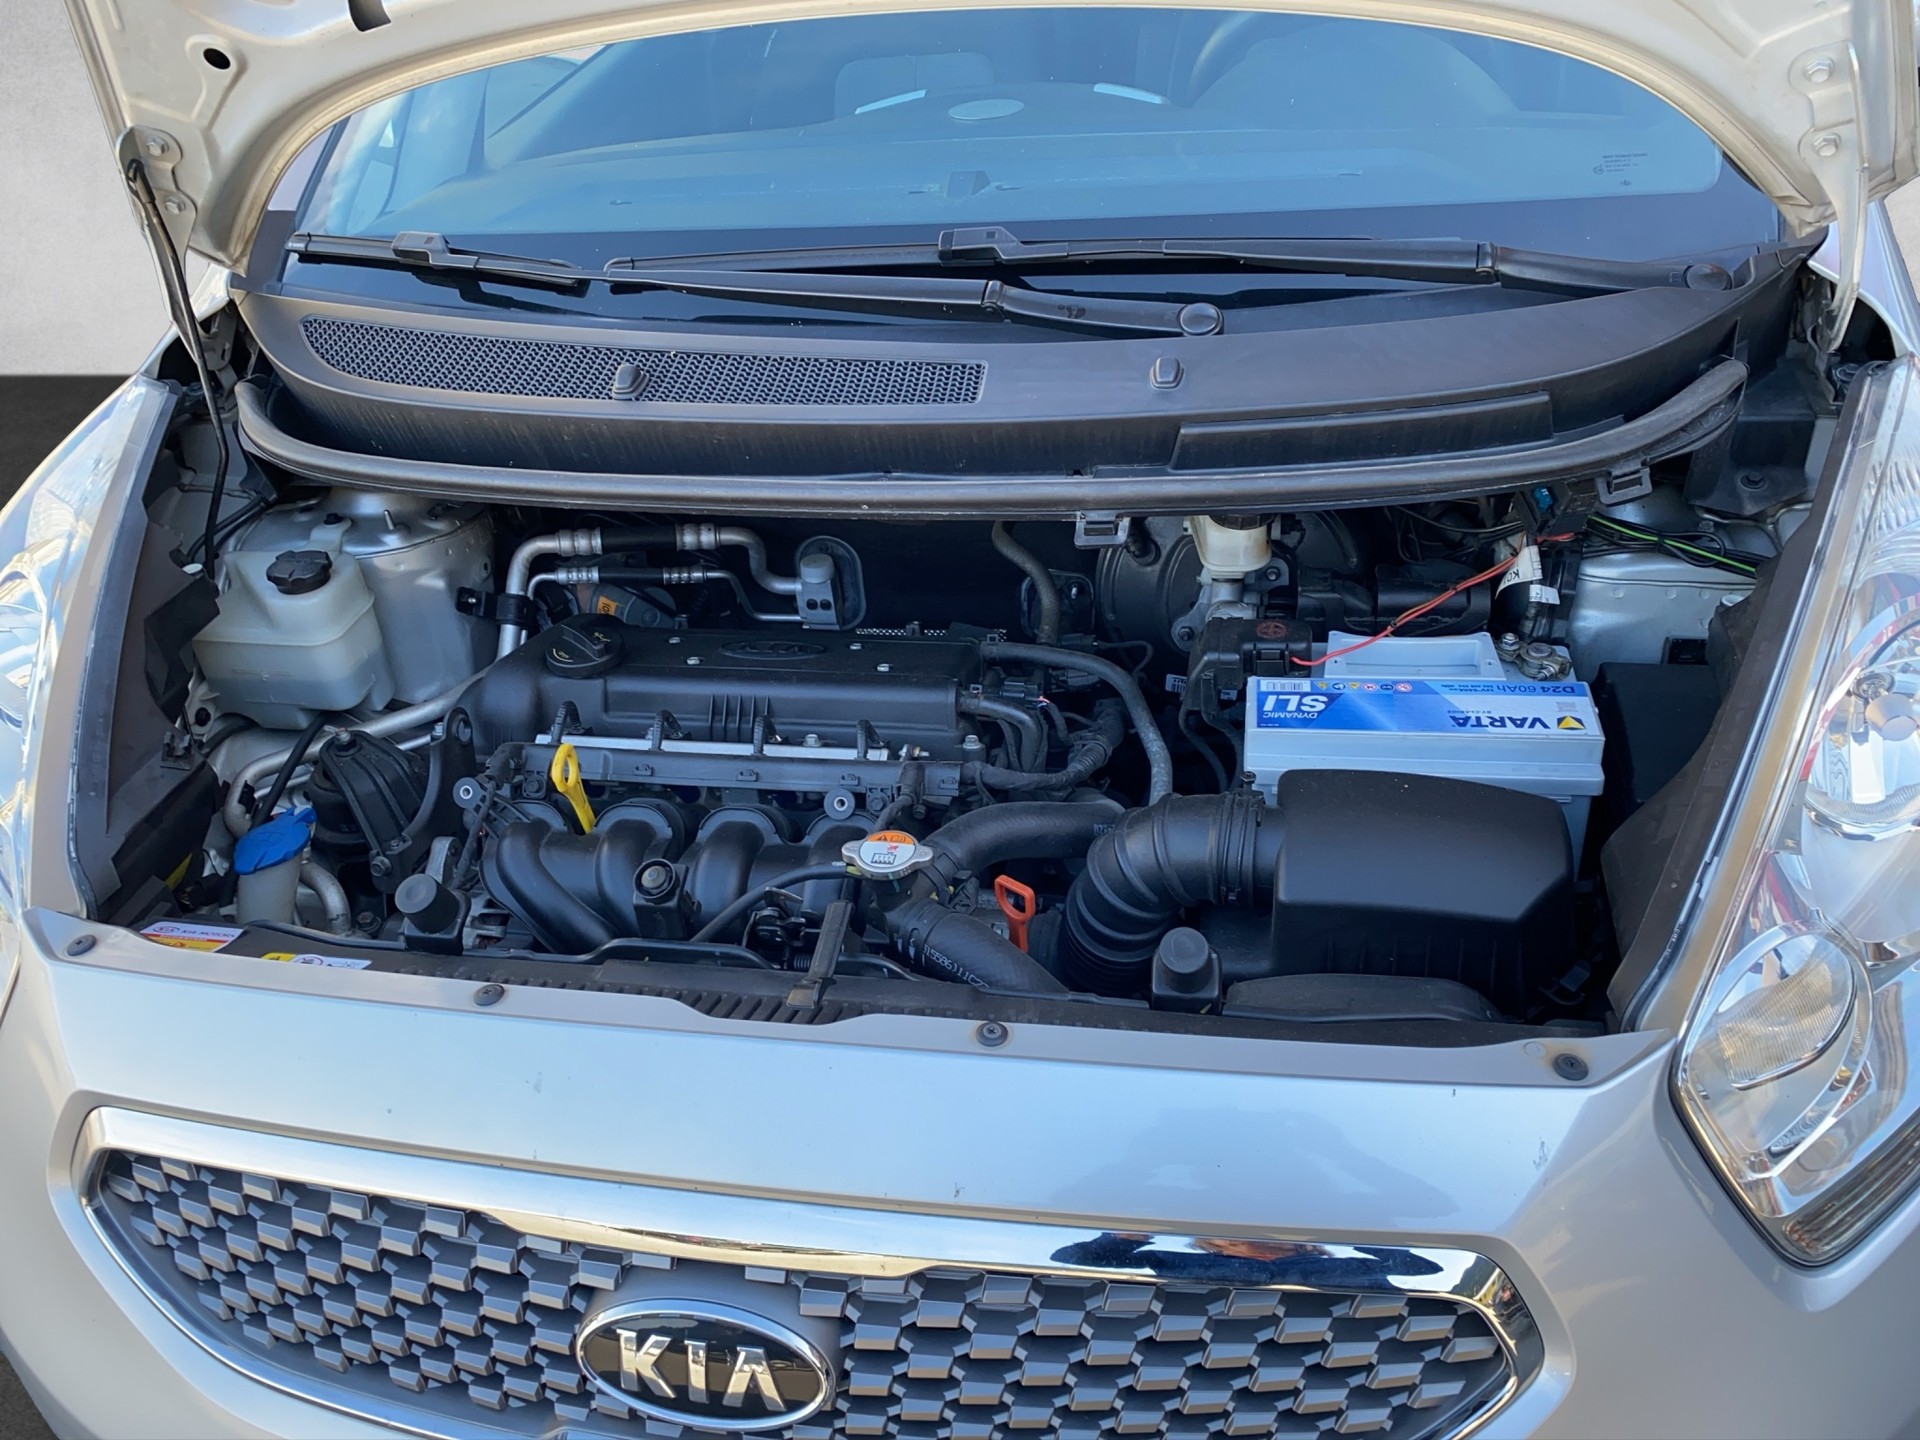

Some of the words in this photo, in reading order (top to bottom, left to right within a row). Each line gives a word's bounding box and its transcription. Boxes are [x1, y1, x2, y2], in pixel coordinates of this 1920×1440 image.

[1497, 684, 1536, 694] 60Ah
[1540, 685, 1576, 694] D24
[1263, 694, 1328, 712] SLI
[1262, 711, 1318, 719] DYNAMIC
[1448, 715, 1551, 730] VARTA
[616, 1328, 787, 1412] KIA
